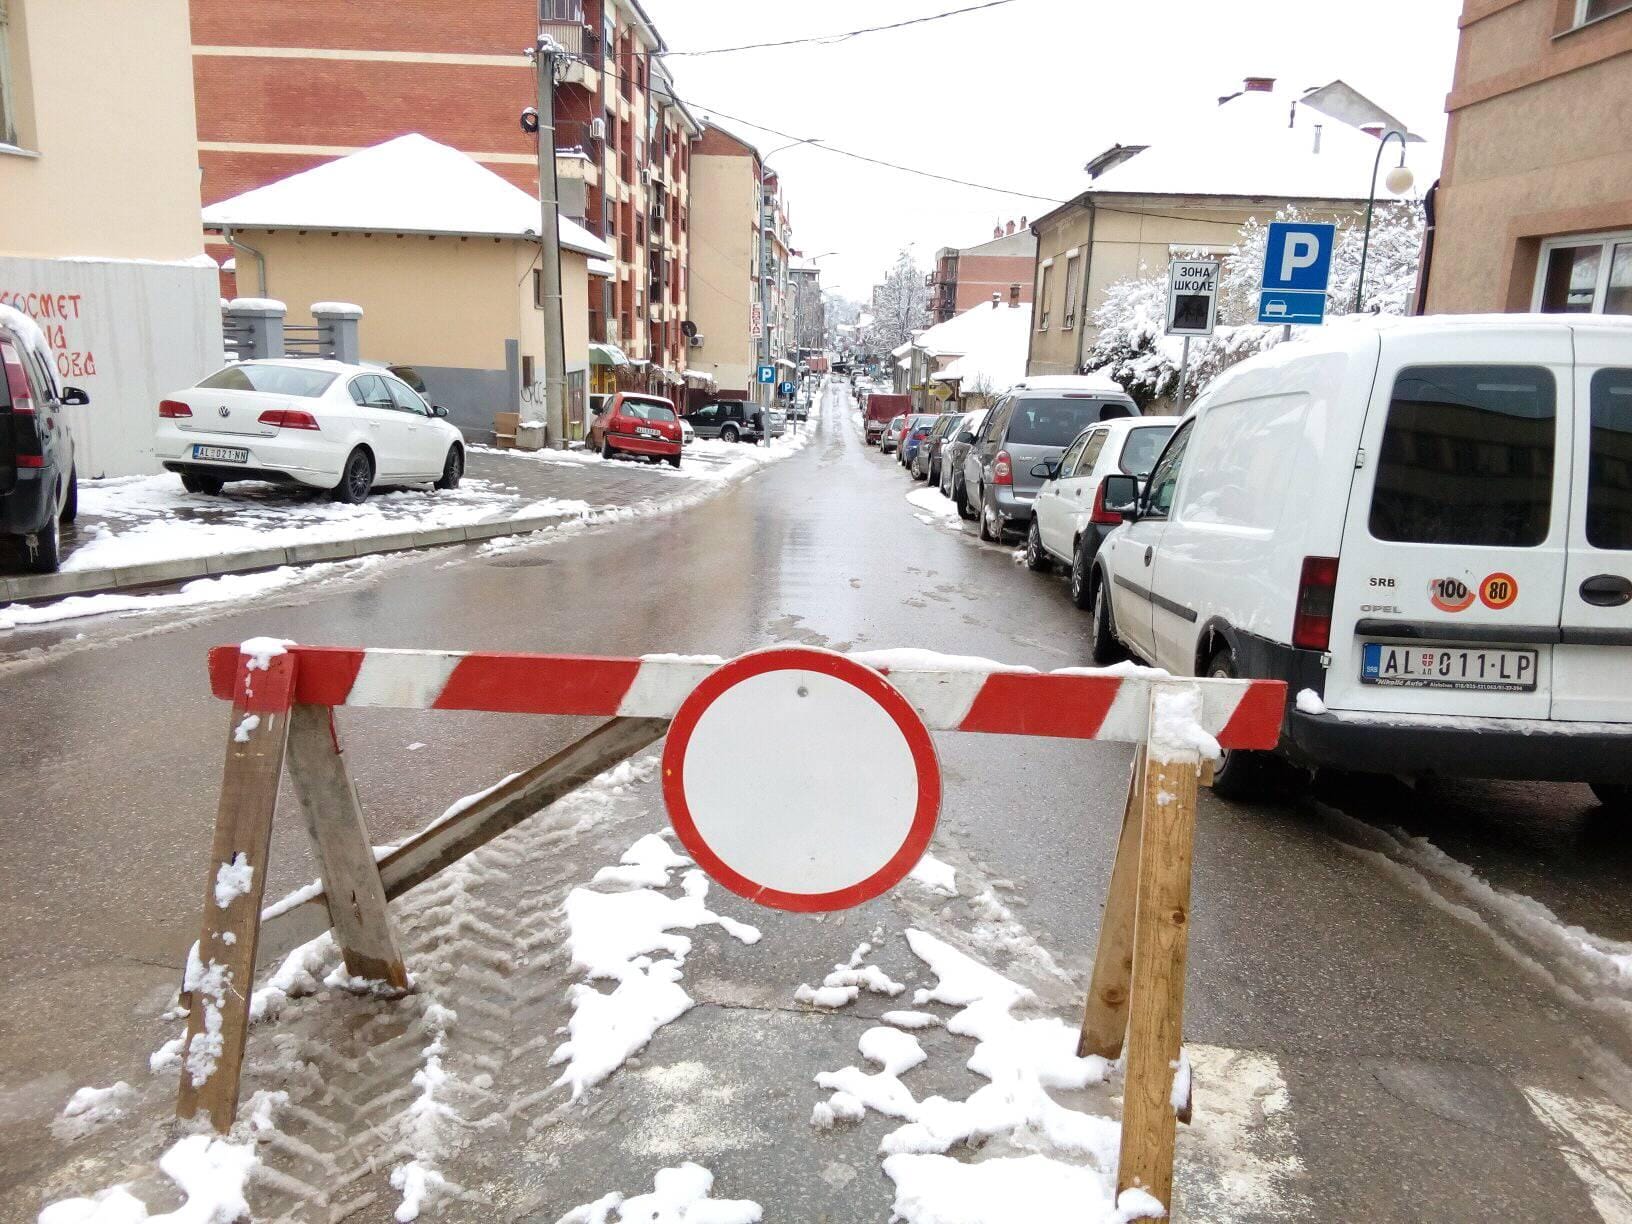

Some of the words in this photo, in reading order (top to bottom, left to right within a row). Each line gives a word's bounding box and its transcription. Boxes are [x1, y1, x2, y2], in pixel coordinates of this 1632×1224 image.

[1280, 232, 1320, 281] P
[1180, 267, 1210, 277] ЗОНА
[1174, 280, 1214, 291] ШКОЛЕ
[762, 368, 772, 381] P
[1369, 577, 1395, 587] SRB
[1438, 580, 1468, 599] 100
[1489, 582, 1508, 600] 80
[1360, 604, 1402, 614] OPEL
